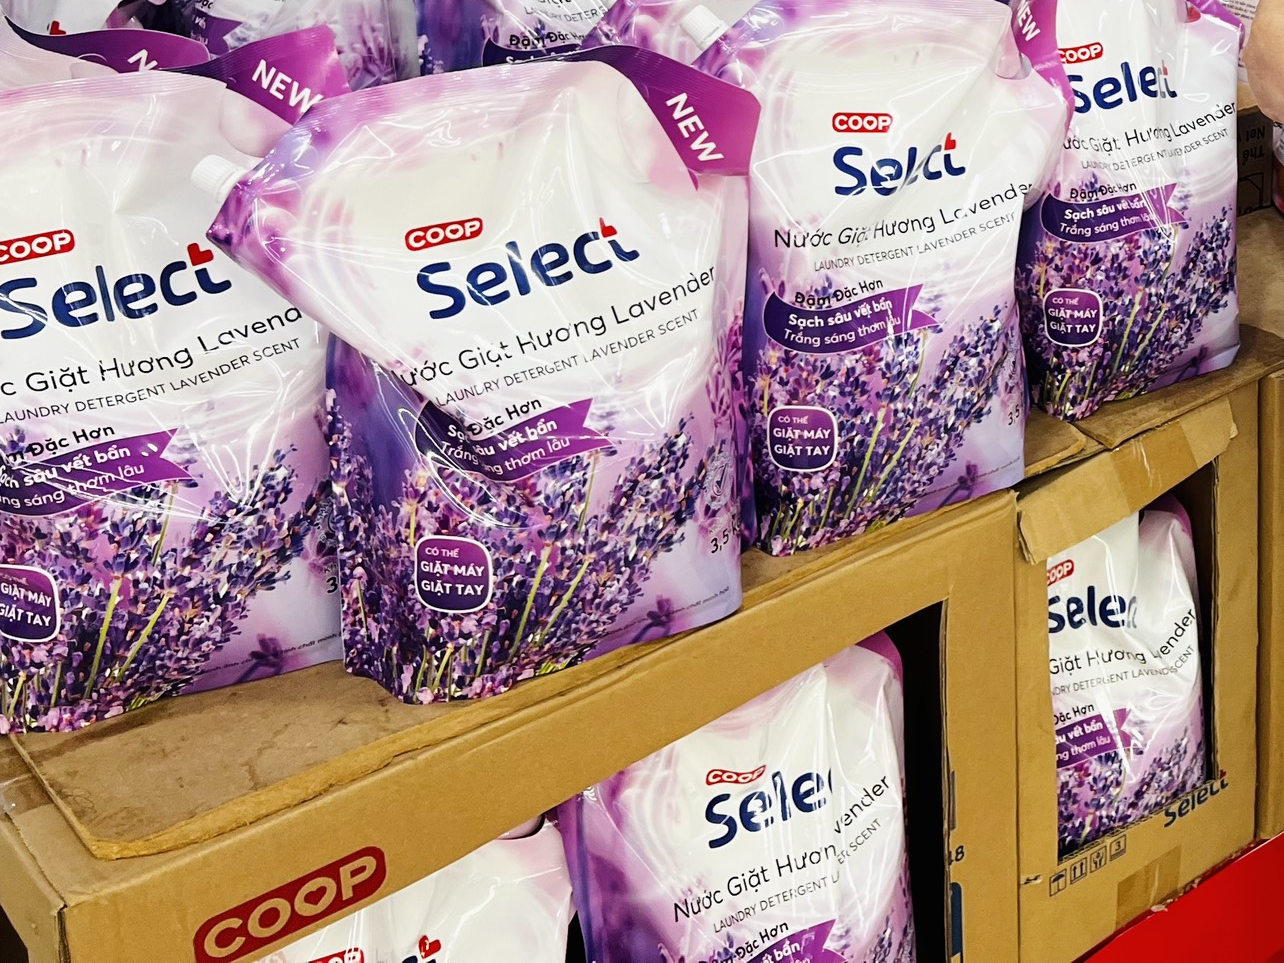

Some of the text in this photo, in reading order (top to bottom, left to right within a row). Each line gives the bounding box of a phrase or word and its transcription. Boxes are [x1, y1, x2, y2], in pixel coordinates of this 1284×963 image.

[665, 92, 725, 164] NEW
[833, 114, 893, 133] COOP
[1064, 206, 1095, 222] Sạch
[407, 219, 481, 249] COOP
[774, 212, 936, 249] Nước Hương
[1060, 219, 1120, 238] Trắng sáng
[416, 217, 641, 320] Select
[813, 245, 914, 273] LAUNDRY DETERGENT
[0, 241, 233, 340] Select
[859, 277, 885, 295] Hơn
[515, 265, 716, 356] Hương Lavender
[787, 306, 852, 331] Sạch sâu
[1048, 307, 1072, 322] GIẶT
[782, 327, 856, 347] Trắng sáng
[1049, 321, 1097, 336] GIẶT TAY
[502, 308, 701, 388] DETERGENT SCENT
[25, 347, 194, 394] Giặt Hương
[75, 337, 302, 413] DETERGENT LAVENDER SCENT
[505, 396, 543, 420] Hơn
[73, 424, 116, 449] Hơn
[497, 417, 559, 451] vết bẩn
[772, 425, 832, 442] GIẶT MÁY
[61, 444, 132, 474] vết bẩn
[504, 435, 571, 473] thơm lâu
[773, 442, 831, 459] GIẶT TAY
[23, 489, 66, 511] sáng
[424, 545, 439, 560] CÓ
[420, 559, 485, 579] GIẶT MÁY
[26, 586, 53, 608] MÁY
[420, 578, 485, 598] GIẶT TAY
[25, 607, 52, 629] TAY
[1073, 702, 1096, 719] Hơn
[203, 854, 379, 959] COOP
[672, 864, 772, 924] Nước Giặt
[712, 903, 758, 935] LAUNDRY
[758, 920, 790, 945] Hơn
